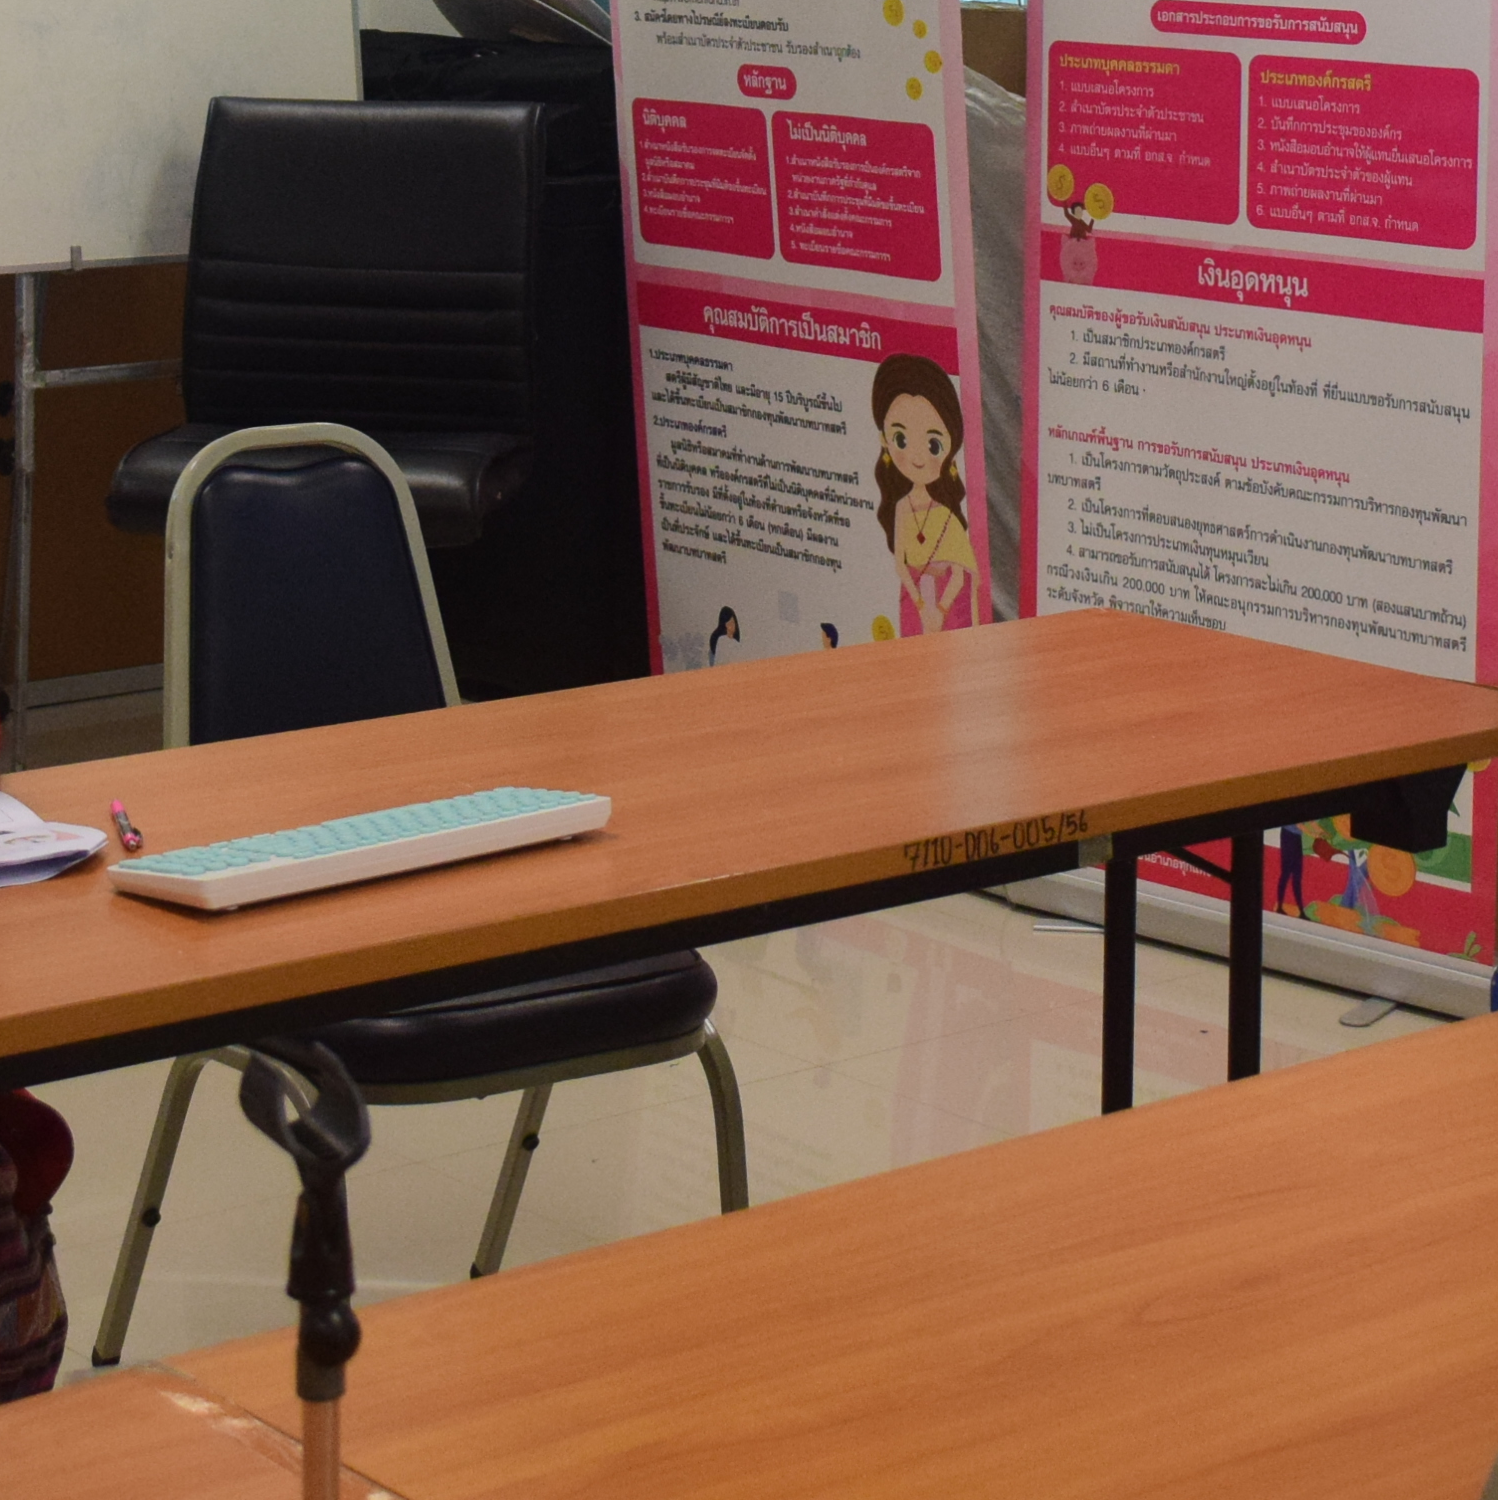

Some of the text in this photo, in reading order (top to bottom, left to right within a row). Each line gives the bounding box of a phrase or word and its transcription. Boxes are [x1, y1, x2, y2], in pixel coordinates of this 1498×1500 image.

[1157, 9, 1358, 37] เอกสารประกอบการขอรับการสนับสนุน
[1059, 54, 1180, 76] ประเภทบุคคลธรรมดา
[743, 70, 787, 93] หลักฐาน
[1060, 81, 1154, 98] 1. แบบเสนอโครงการ
[1260, 68, 1372, 92] ประเภทองค์กรสตรี
[1059, 101, 1067, 111] 2.
[1259, 96, 1360, 115] 1. แบบเสนอโครงการ
[642, 108, 687, 133] นิติบุคคล
[1059, 122, 1067, 132] 3.
[786, 119, 866, 151] ไม่เป็นนิติบุคคล
[1257, 161, 1266, 173] 4.
[1197, 257, 1308, 306] เงินอุดหนุน
[703, 304, 882, 351] คุณสมบัติการเป็นสมาชิก
[1071, 330, 1079, 342] 1.
[1215, 322, 1312, 350] ประเภทเงินอุดหนุน
[1048, 367, 1139, 397] ไม่น้อยกว่า 6 เดือน
[1047, 472, 1102, 493] บทบาทสตรี
[1169, 584, 1191, 600] บาท
